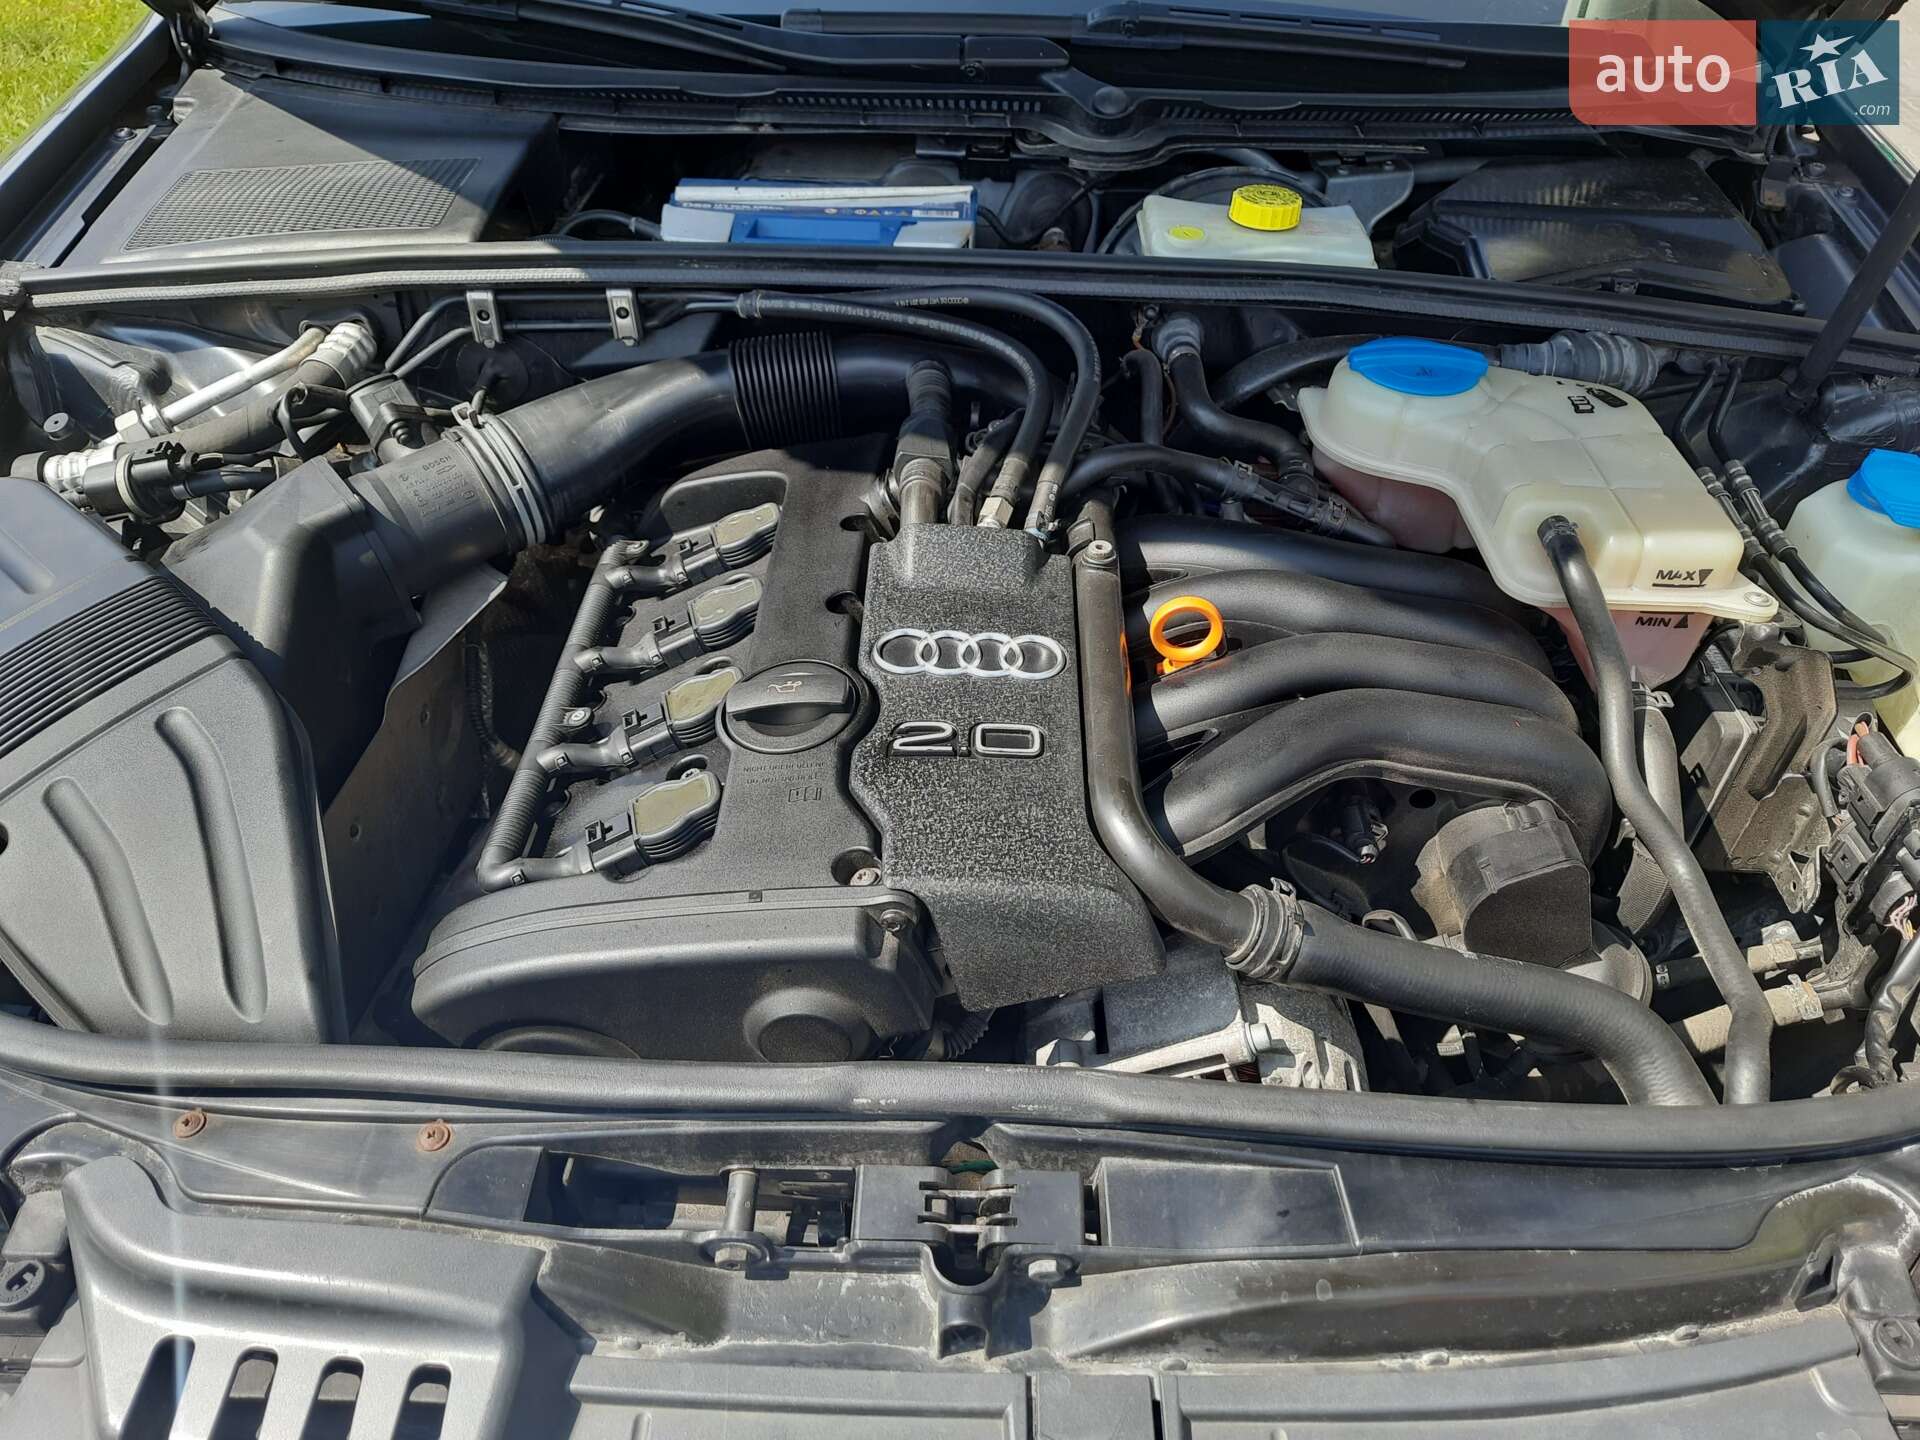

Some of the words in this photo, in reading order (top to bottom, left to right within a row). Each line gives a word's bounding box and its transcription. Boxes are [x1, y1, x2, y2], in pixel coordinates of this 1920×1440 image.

[1656, 569, 1697, 581] MAX
[1635, 616, 1672, 628] MIN
[889, 721, 1043, 758] 2.0
